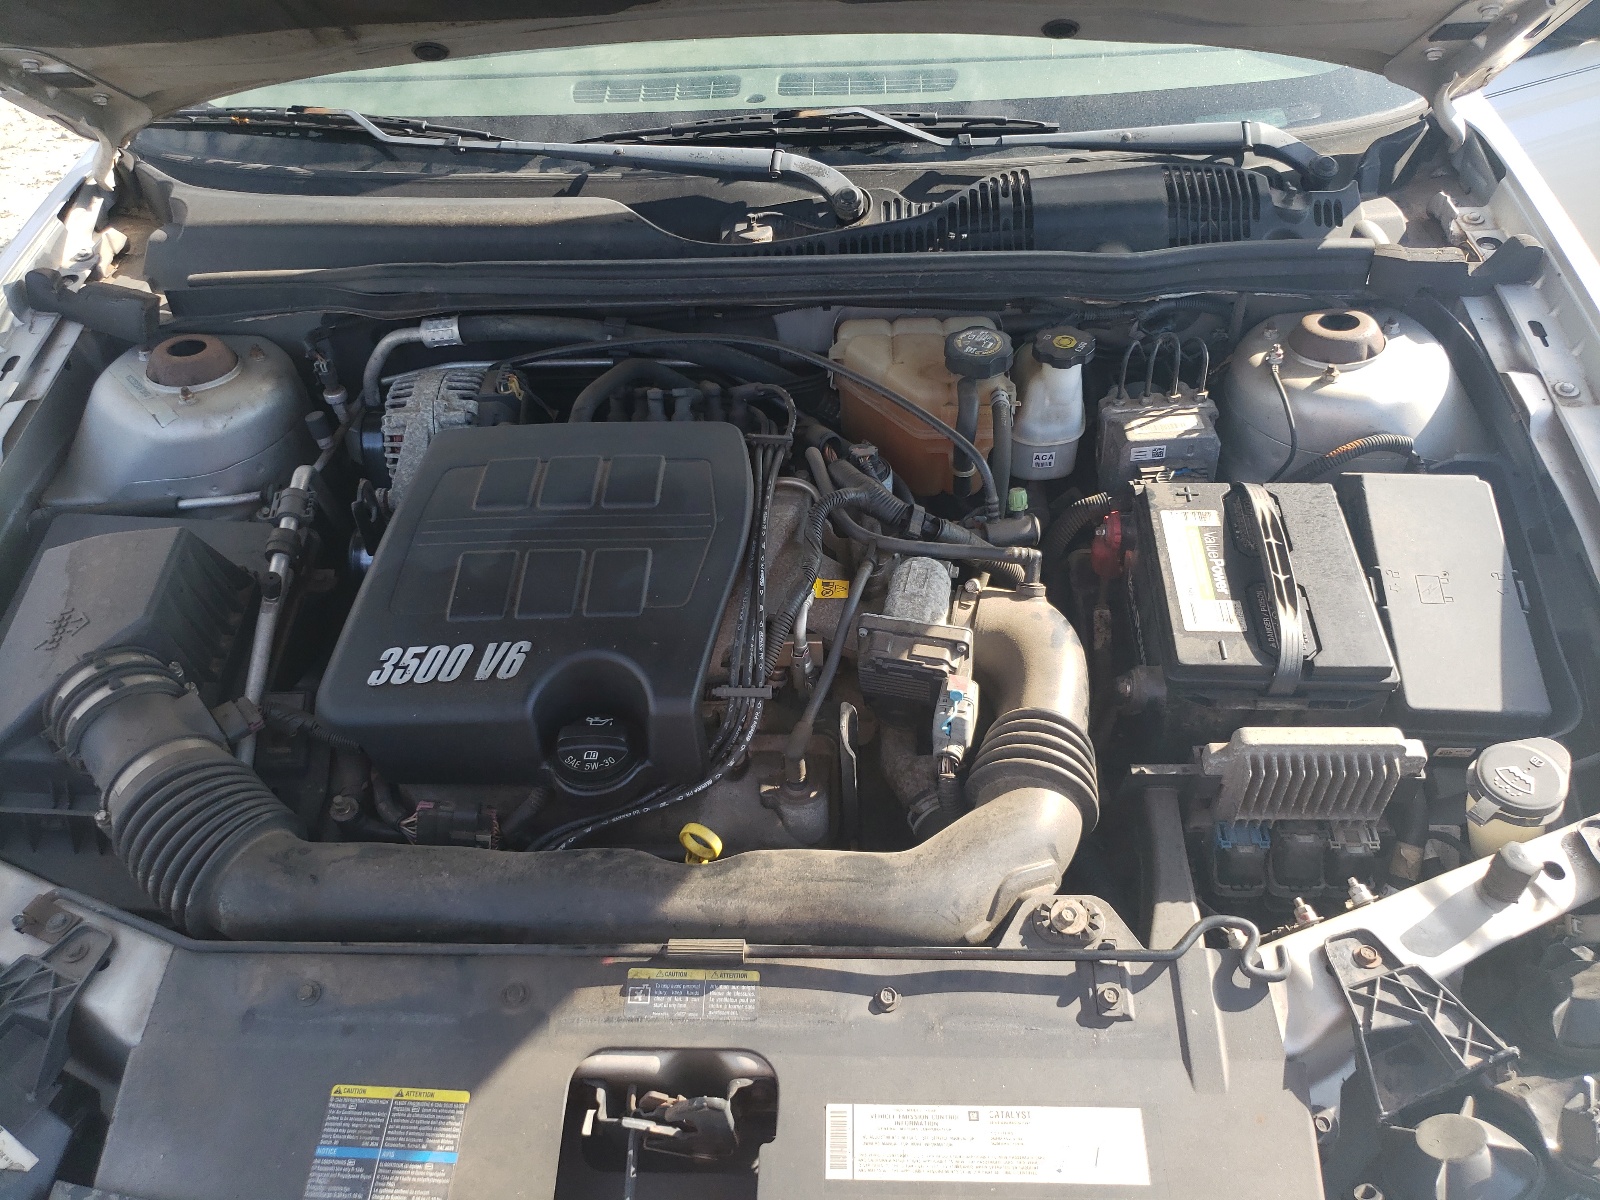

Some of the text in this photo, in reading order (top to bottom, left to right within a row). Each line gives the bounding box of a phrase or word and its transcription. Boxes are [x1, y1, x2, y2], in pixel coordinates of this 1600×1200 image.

[1256, 589, 1269, 612] POISON
[366, 640, 533, 687] 3500 V6
[564, 755, 581, 770] SAE
[343, 1087, 367, 1095] CAUTION
[405, 1090, 435, 1098] ATTENTION
[988, 1110, 1031, 1119] CATALYST
[316, 1147, 337, 1155] NOTICE
